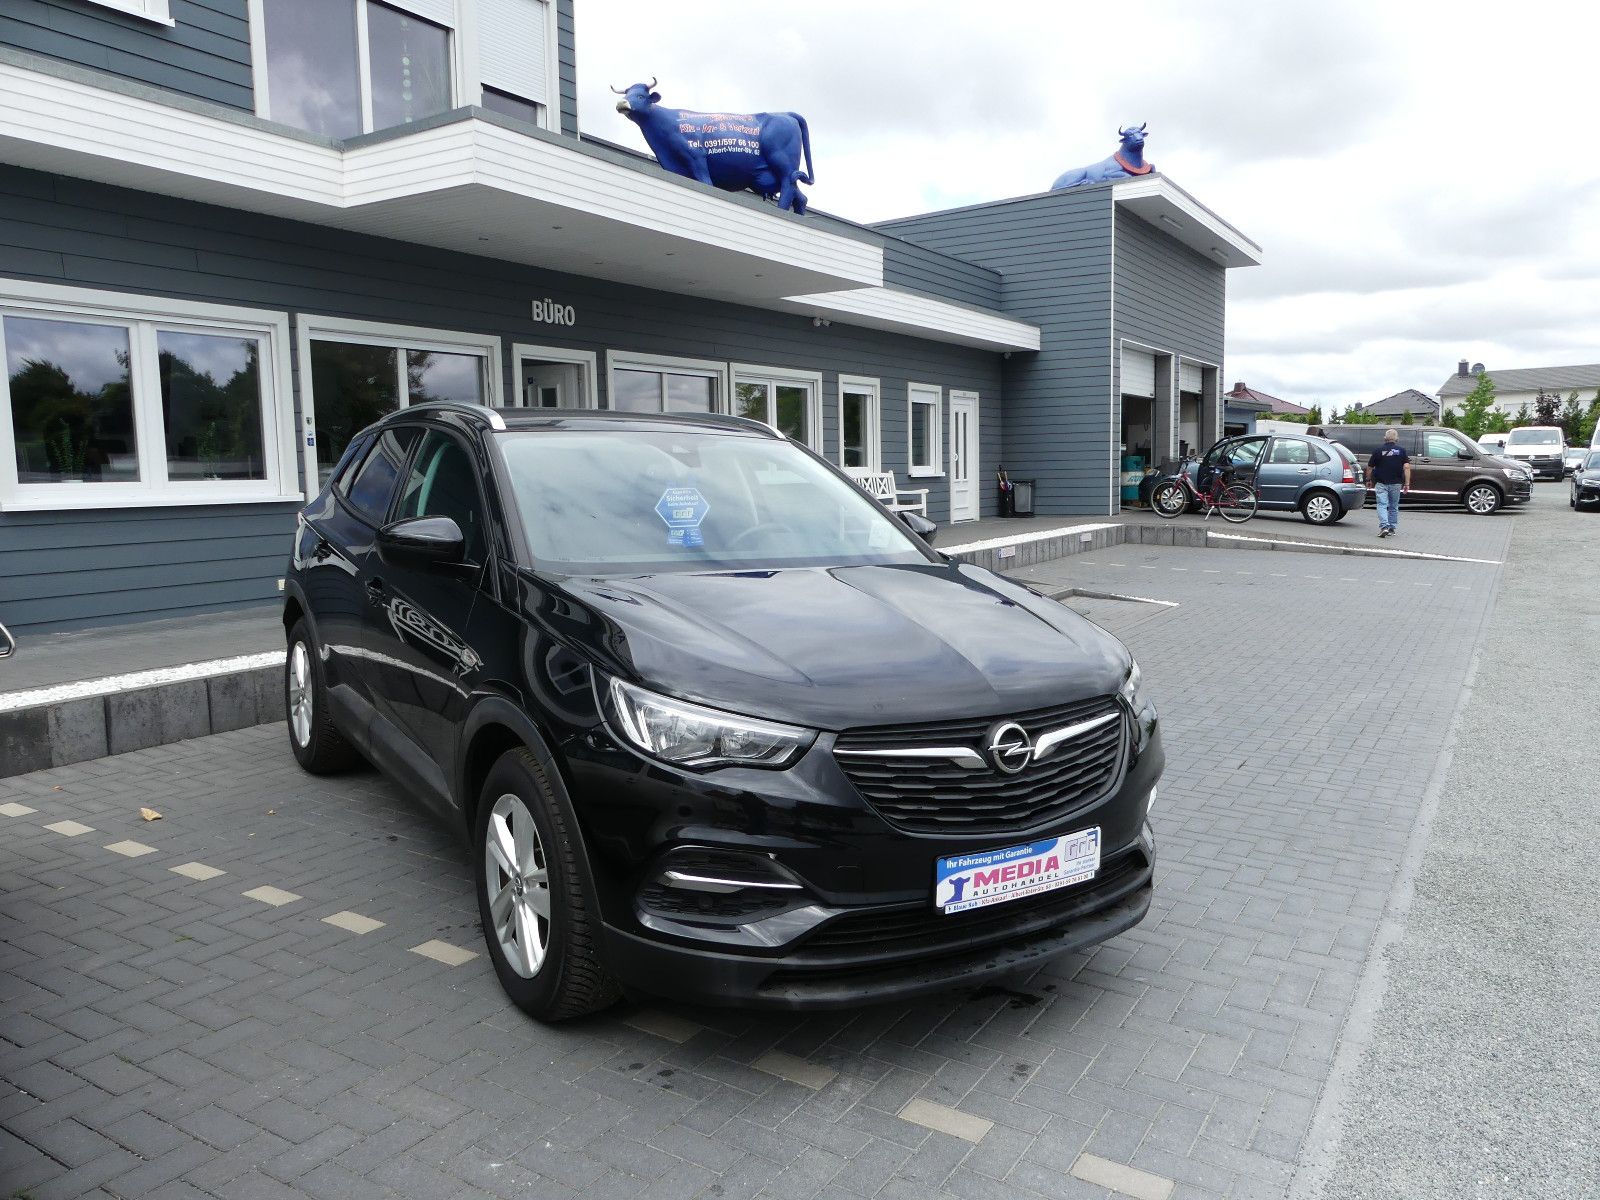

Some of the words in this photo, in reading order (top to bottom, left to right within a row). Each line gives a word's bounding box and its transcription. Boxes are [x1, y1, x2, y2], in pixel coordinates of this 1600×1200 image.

[688, 140, 703, 148] Tel.
[747, 141, 760, 149] 100
[531, 297, 576, 326] BÜRO
[946, 860, 958, 869] Ihr
[958, 855, 992, 867] Fahrzeug
[992, 852, 1005, 862] mit
[1005, 846, 1033, 859] Garantie
[972, 872, 1059, 897] AUTOHANDEL
[973, 855, 1060, 889] MEDIA
